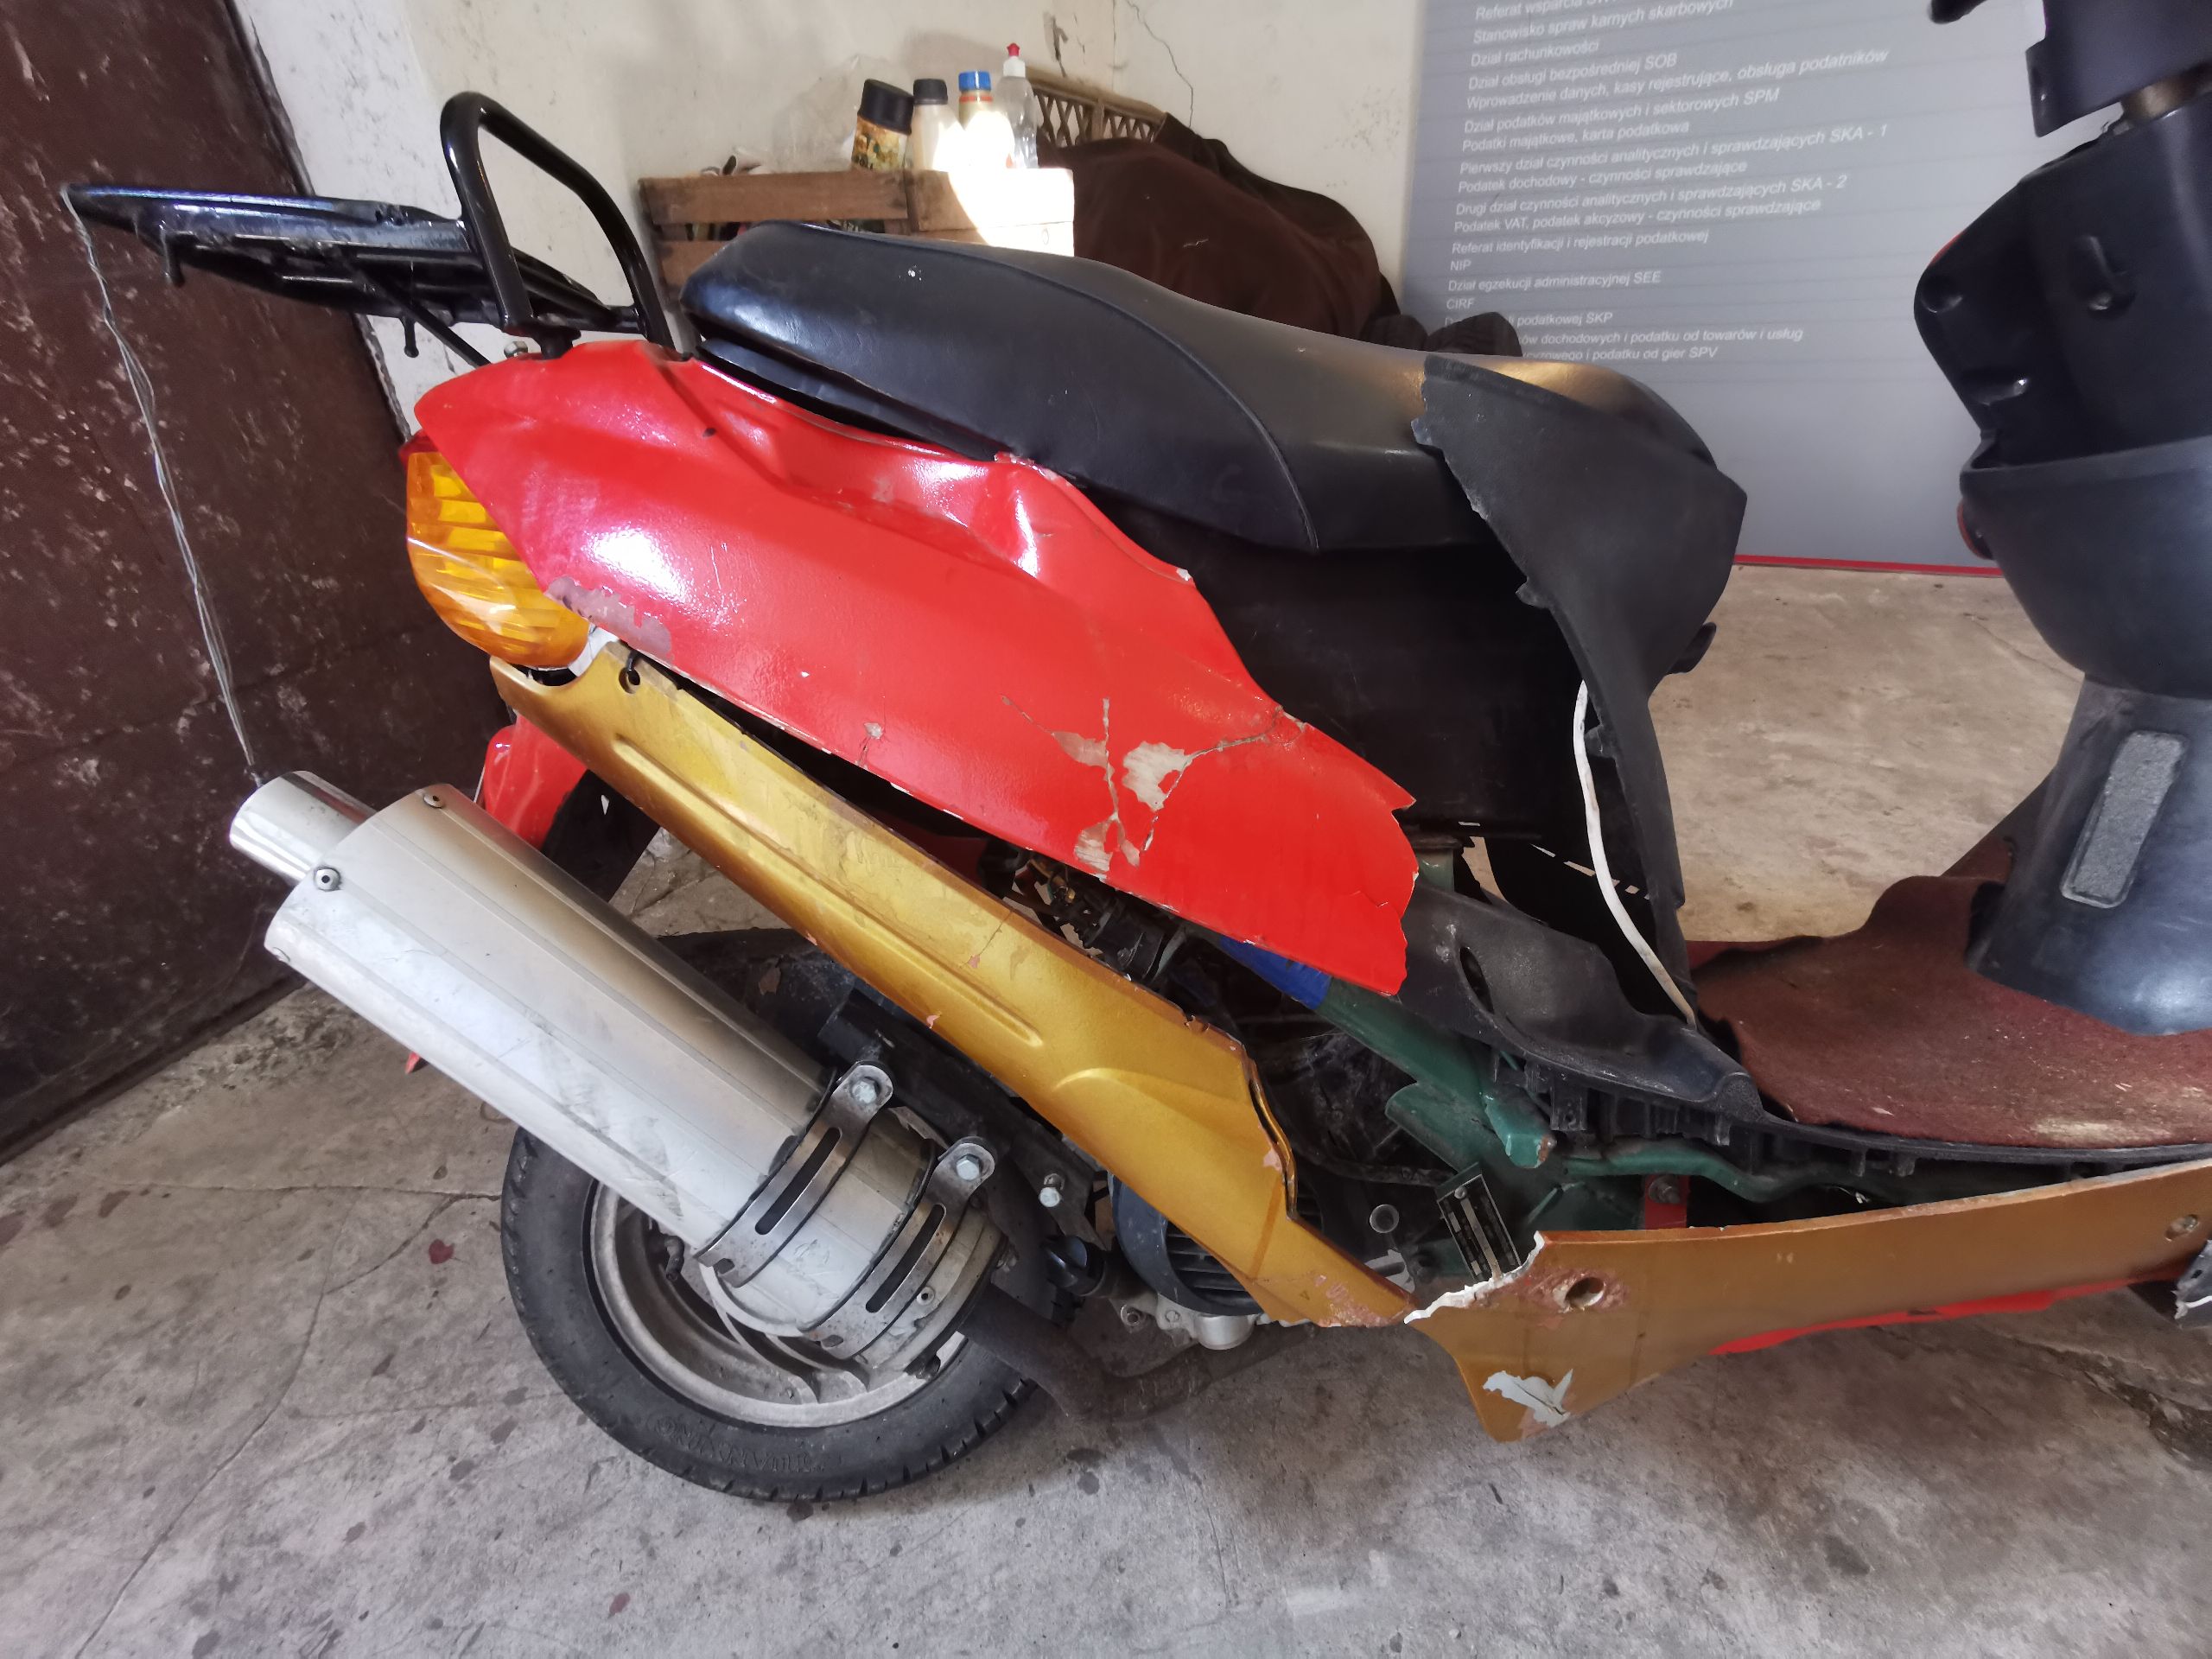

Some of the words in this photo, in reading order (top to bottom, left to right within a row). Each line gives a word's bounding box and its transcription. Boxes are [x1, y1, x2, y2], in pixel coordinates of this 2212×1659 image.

[1744, 87, 1780, 105] SPM
[1582, 129, 1613, 141] karta
[1829, 126, 1863, 143] SKA
[1790, 175, 1822, 193] SKA
[1450, 260, 1471, 271] NIP
[1633, 270, 1662, 284] SEE
[1586, 311, 1613, 324] SKP
[1630, 329, 1680, 345] podatku
[1683, 330, 1700, 342] od
[1592, 347, 1640, 361] podatku
[1643, 347, 1658, 359] od
[1688, 346, 1719, 359] SPV
